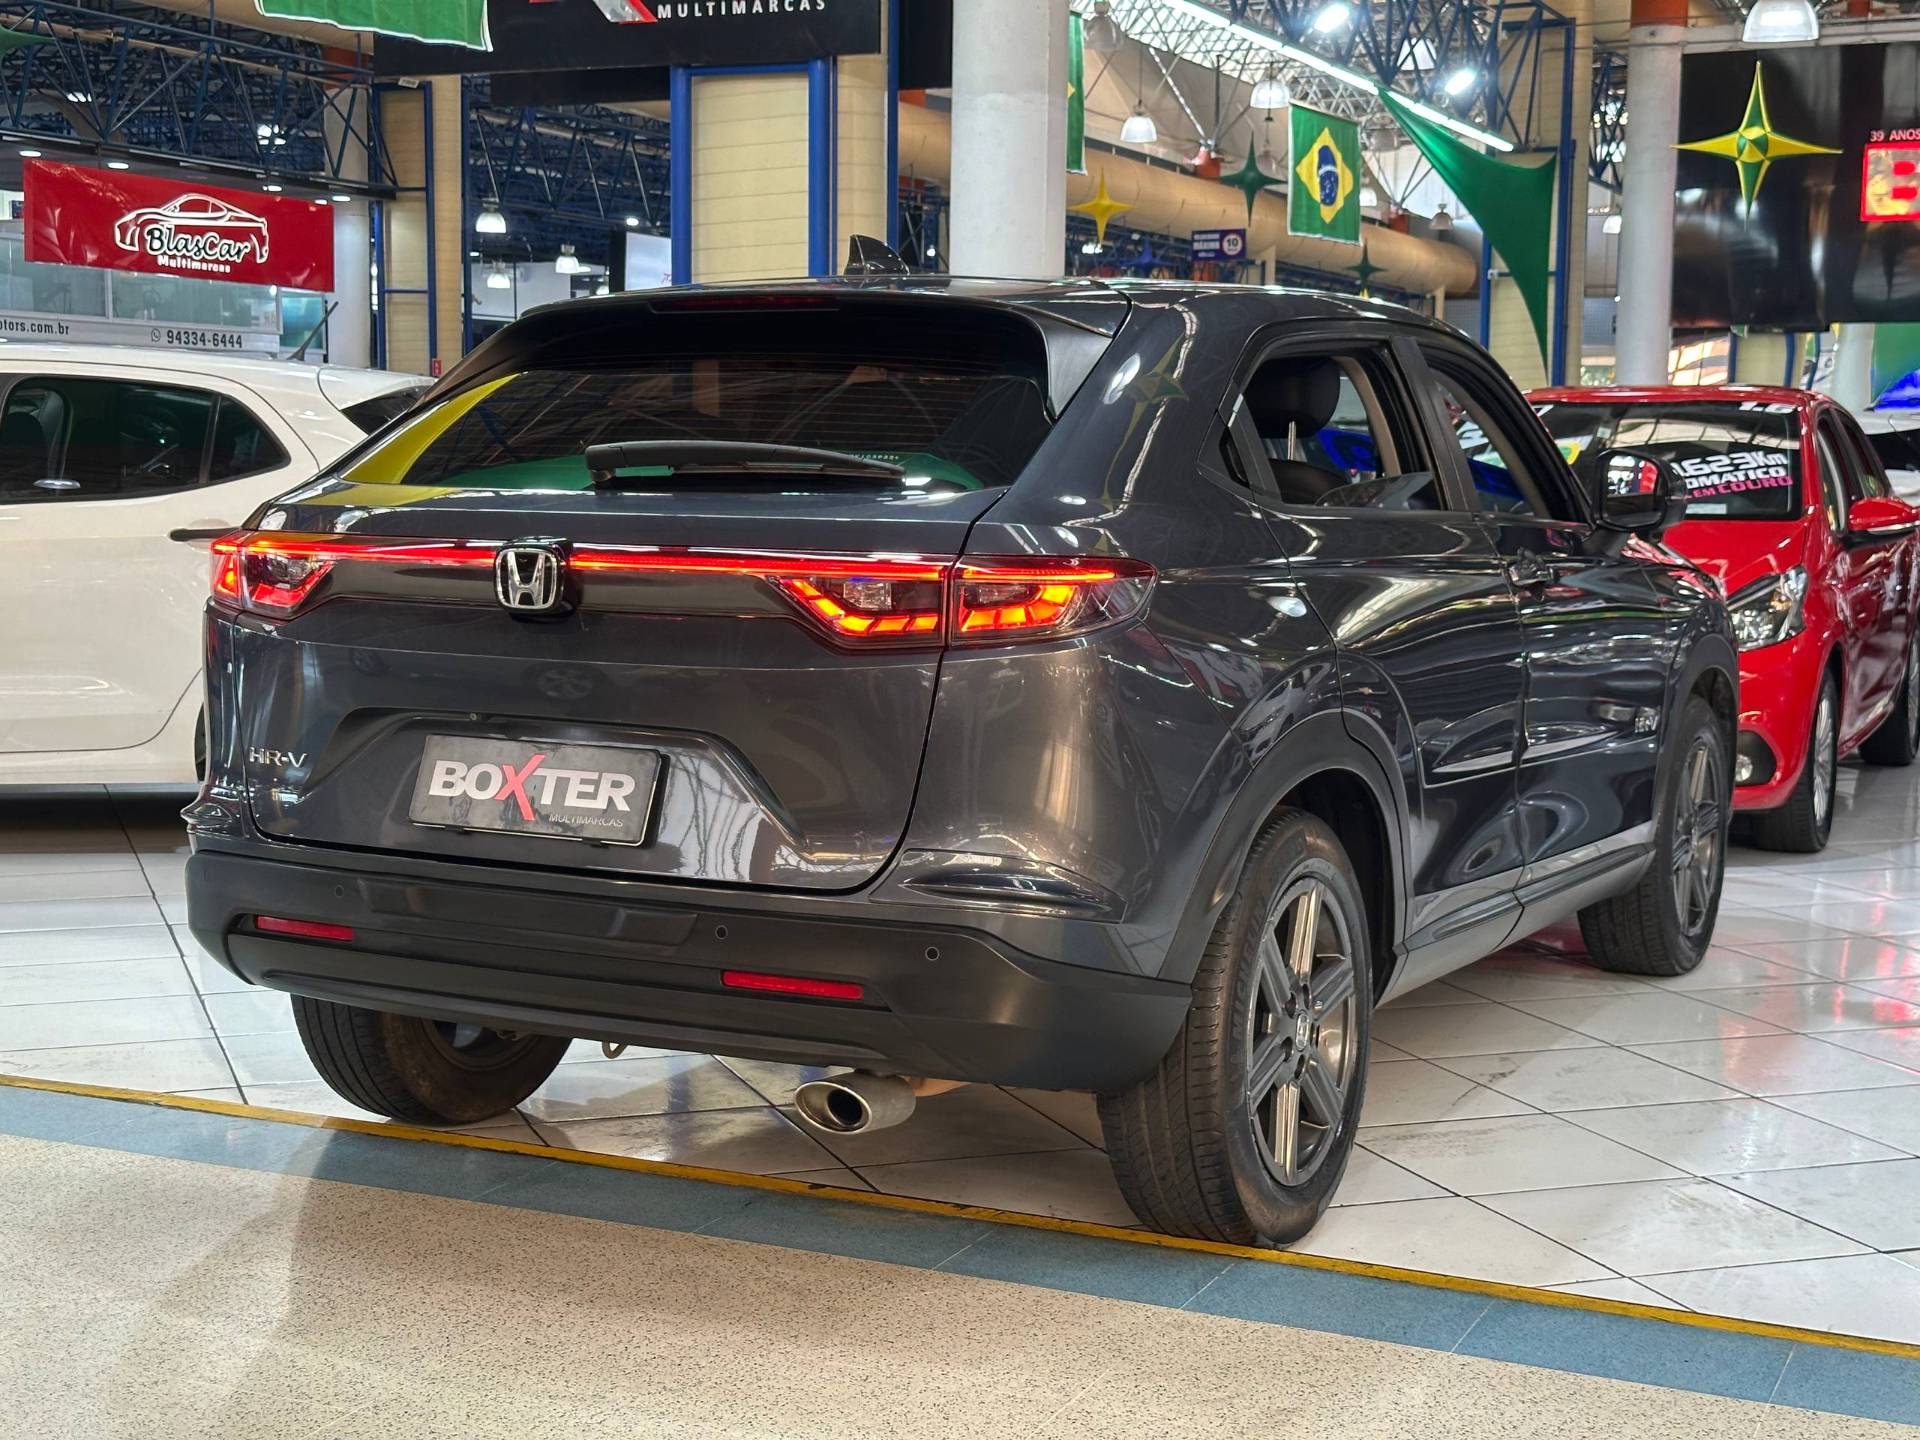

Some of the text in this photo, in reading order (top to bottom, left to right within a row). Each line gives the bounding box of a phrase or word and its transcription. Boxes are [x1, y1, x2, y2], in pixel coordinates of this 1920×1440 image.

[657, 0, 826, 19] MULTIMARCAS
[1870, 130, 1885, 141] 39
[145, 222, 250, 262] BlasCar
[1227, 238, 1239, 247] 10
[157, 255, 231, 273] Multimarcas
[166, 330, 243, 348] 94334-6444
[1717, 475, 1793, 494] COURO
[249, 746, 308, 768] HR-V
[429, 754, 636, 821] BOXTER
[548, 813, 624, 828] MULTIMARCAS
